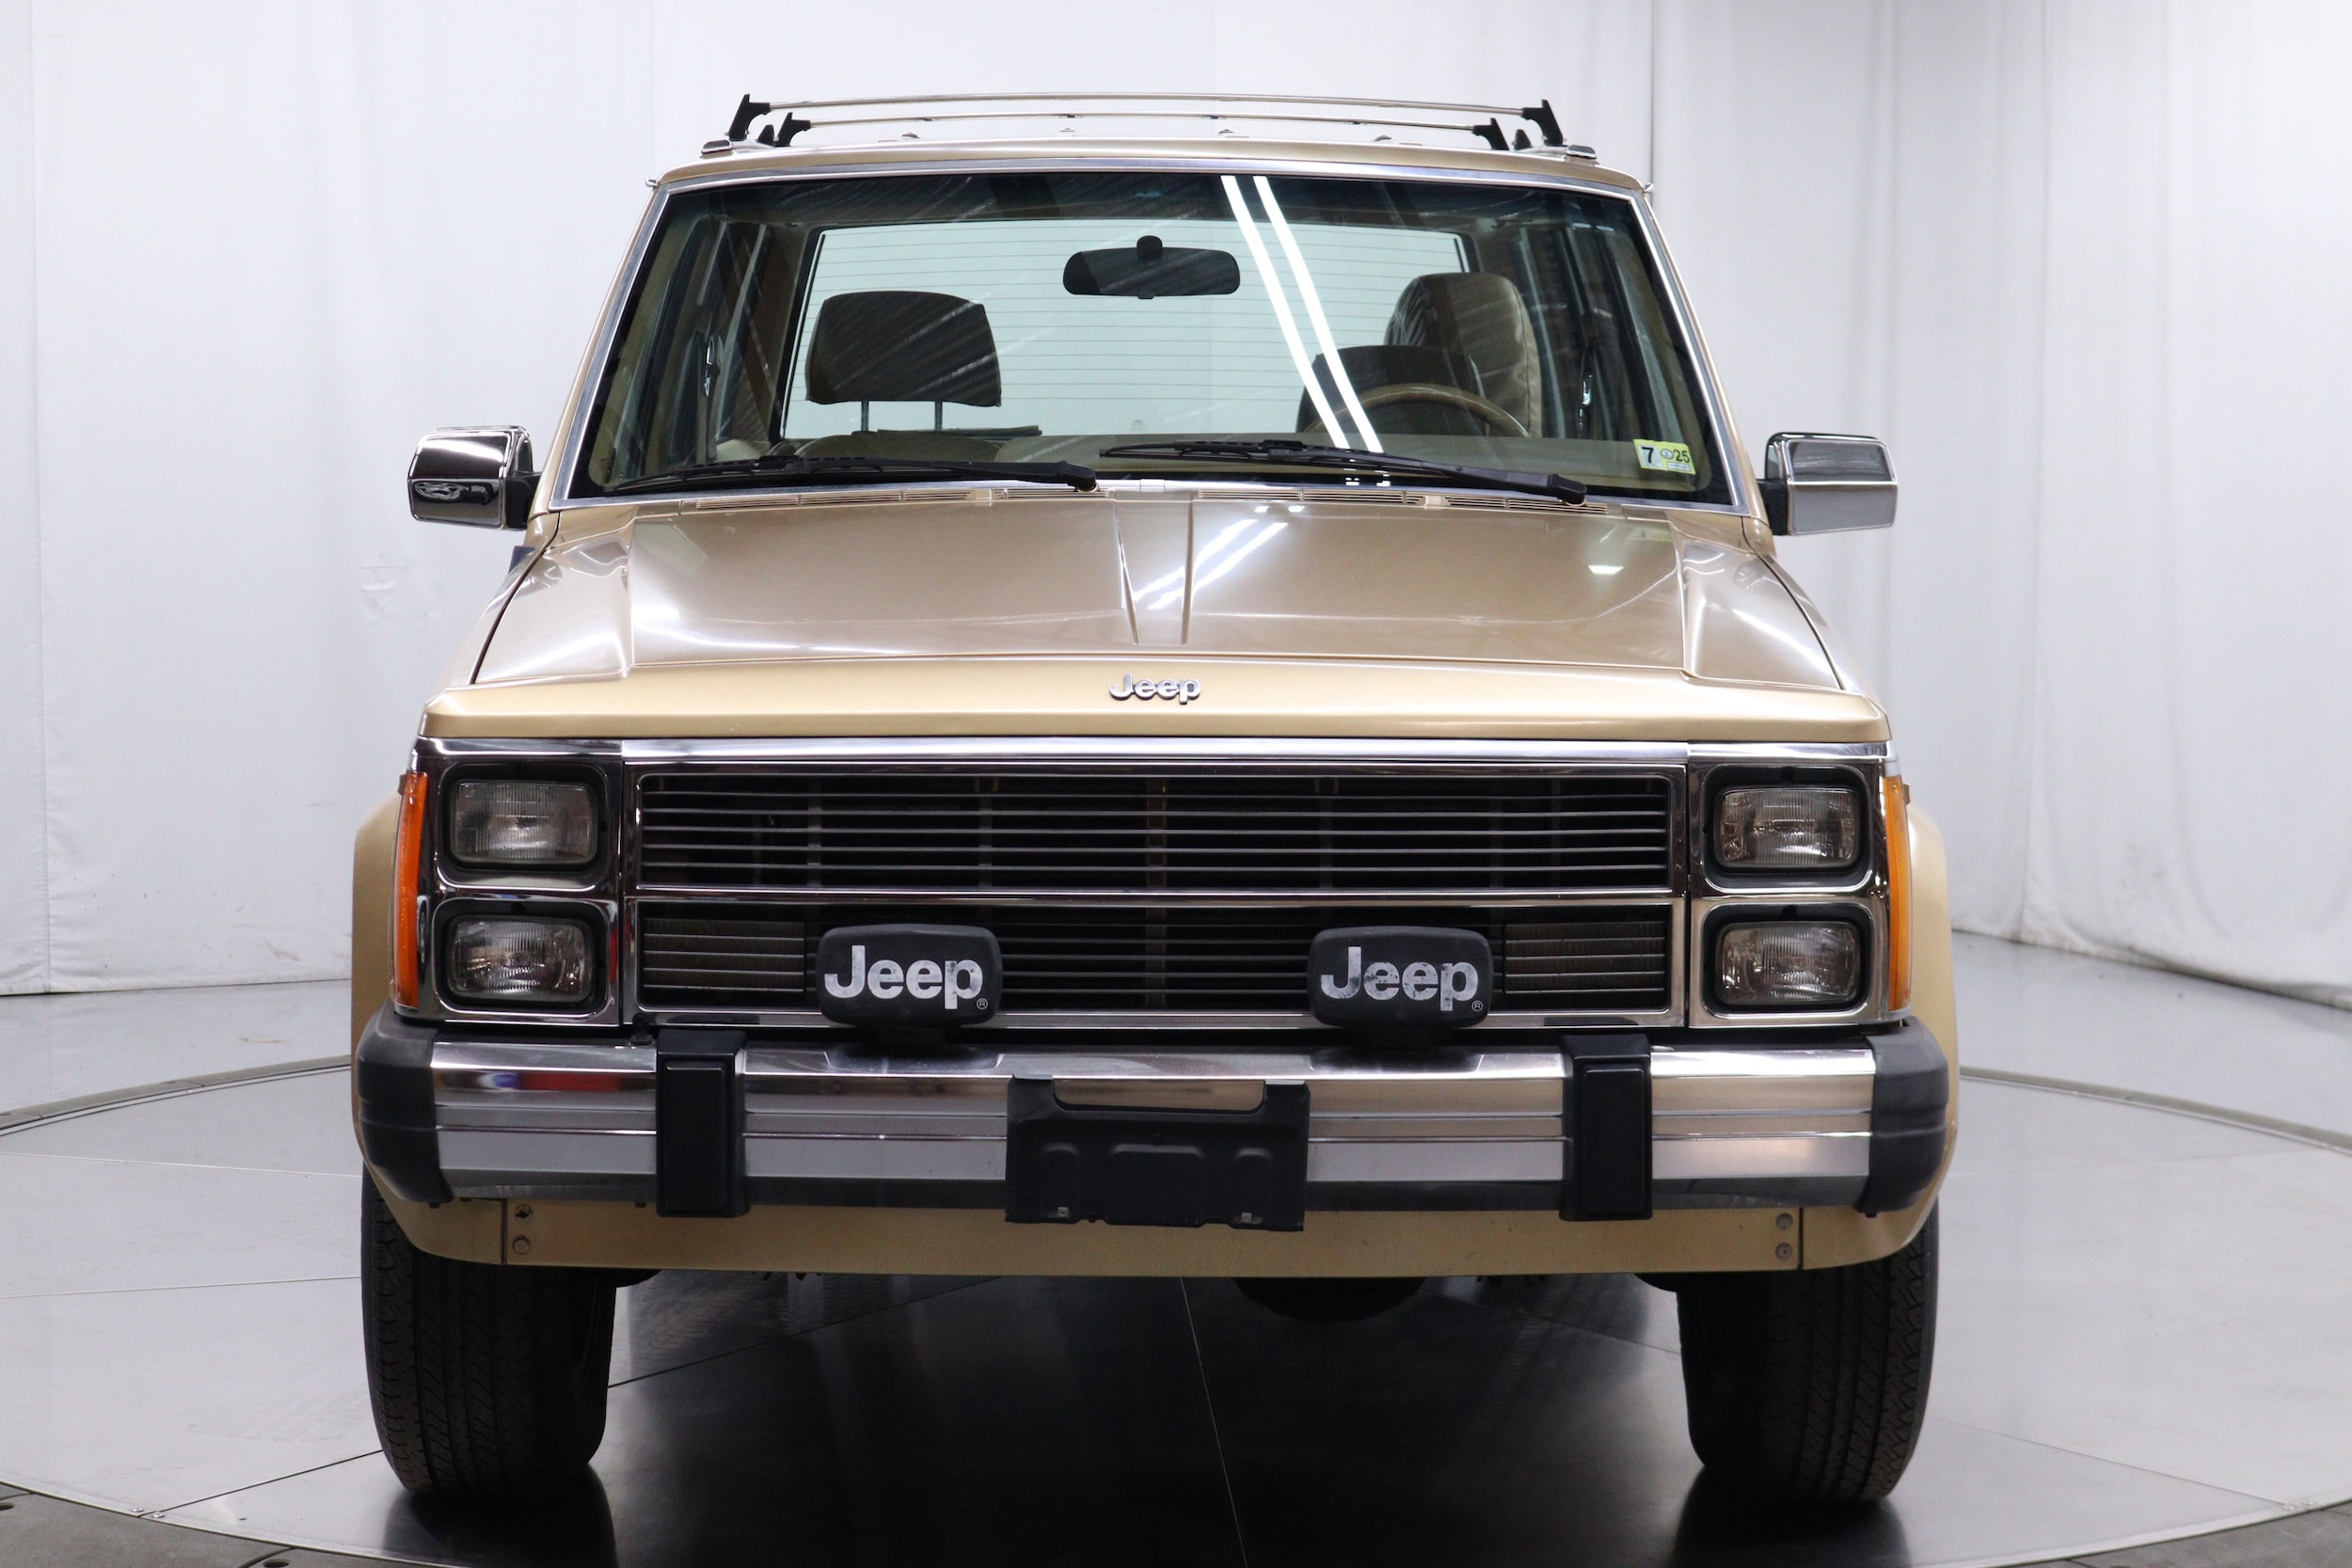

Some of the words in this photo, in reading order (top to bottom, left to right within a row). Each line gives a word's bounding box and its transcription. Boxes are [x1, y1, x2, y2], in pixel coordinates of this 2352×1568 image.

[1641, 446, 1654, 464] 7
[1674, 449, 1691, 464] 25
[1109, 673, 1201, 705] Jeep
[824, 944, 983, 1010] Jeep
[1320, 945, 1479, 1012] Jeep
